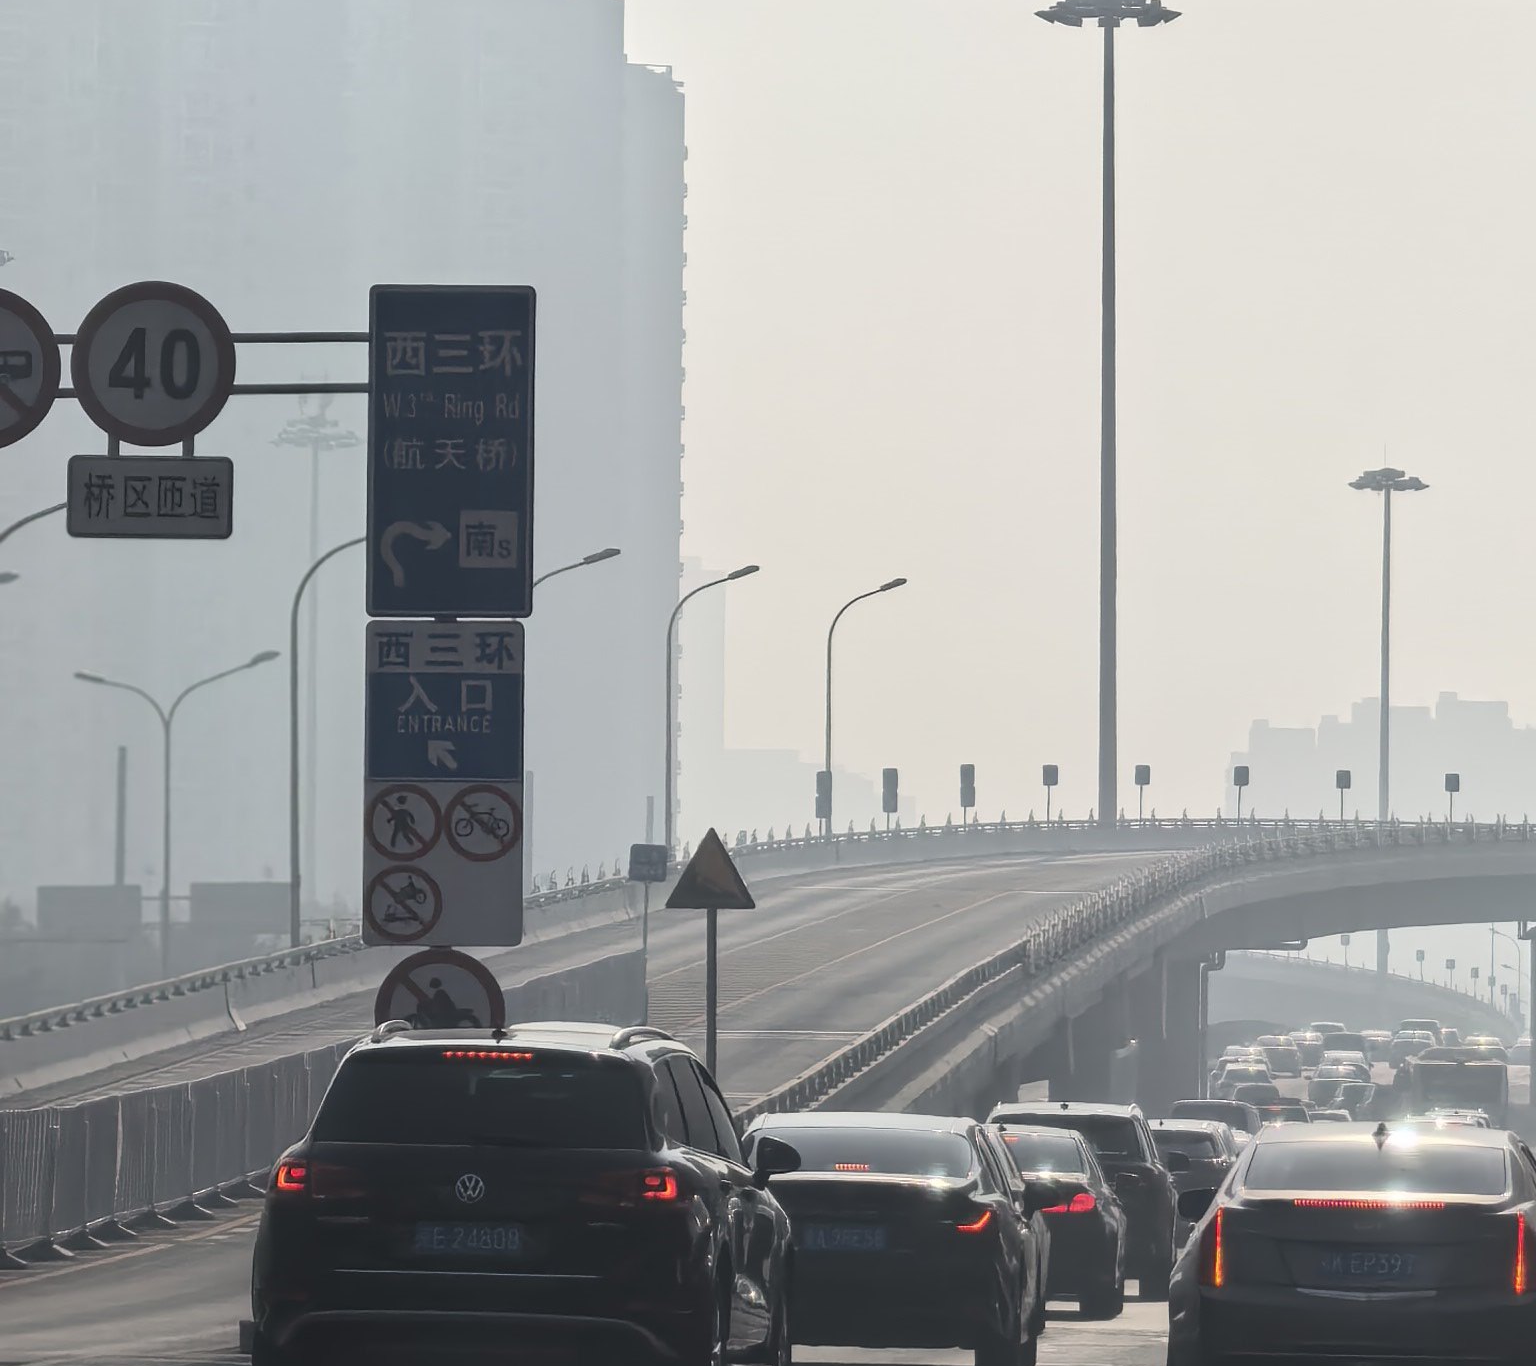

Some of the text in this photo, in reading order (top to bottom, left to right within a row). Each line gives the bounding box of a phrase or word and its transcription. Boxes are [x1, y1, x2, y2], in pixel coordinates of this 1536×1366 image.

[108, 327, 201, 401] 40
[383, 329, 524, 377] 西三环
[444, 392, 485, 426] Ring
[495, 392, 521, 420] Rd
[83, 472, 221, 520] 桥区匝道
[464, 521, 498, 557] 南
[374, 630, 516, 671] 西三环
[397, 674, 494, 713] 入口
[396, 715, 492, 734] ENTRANCE
